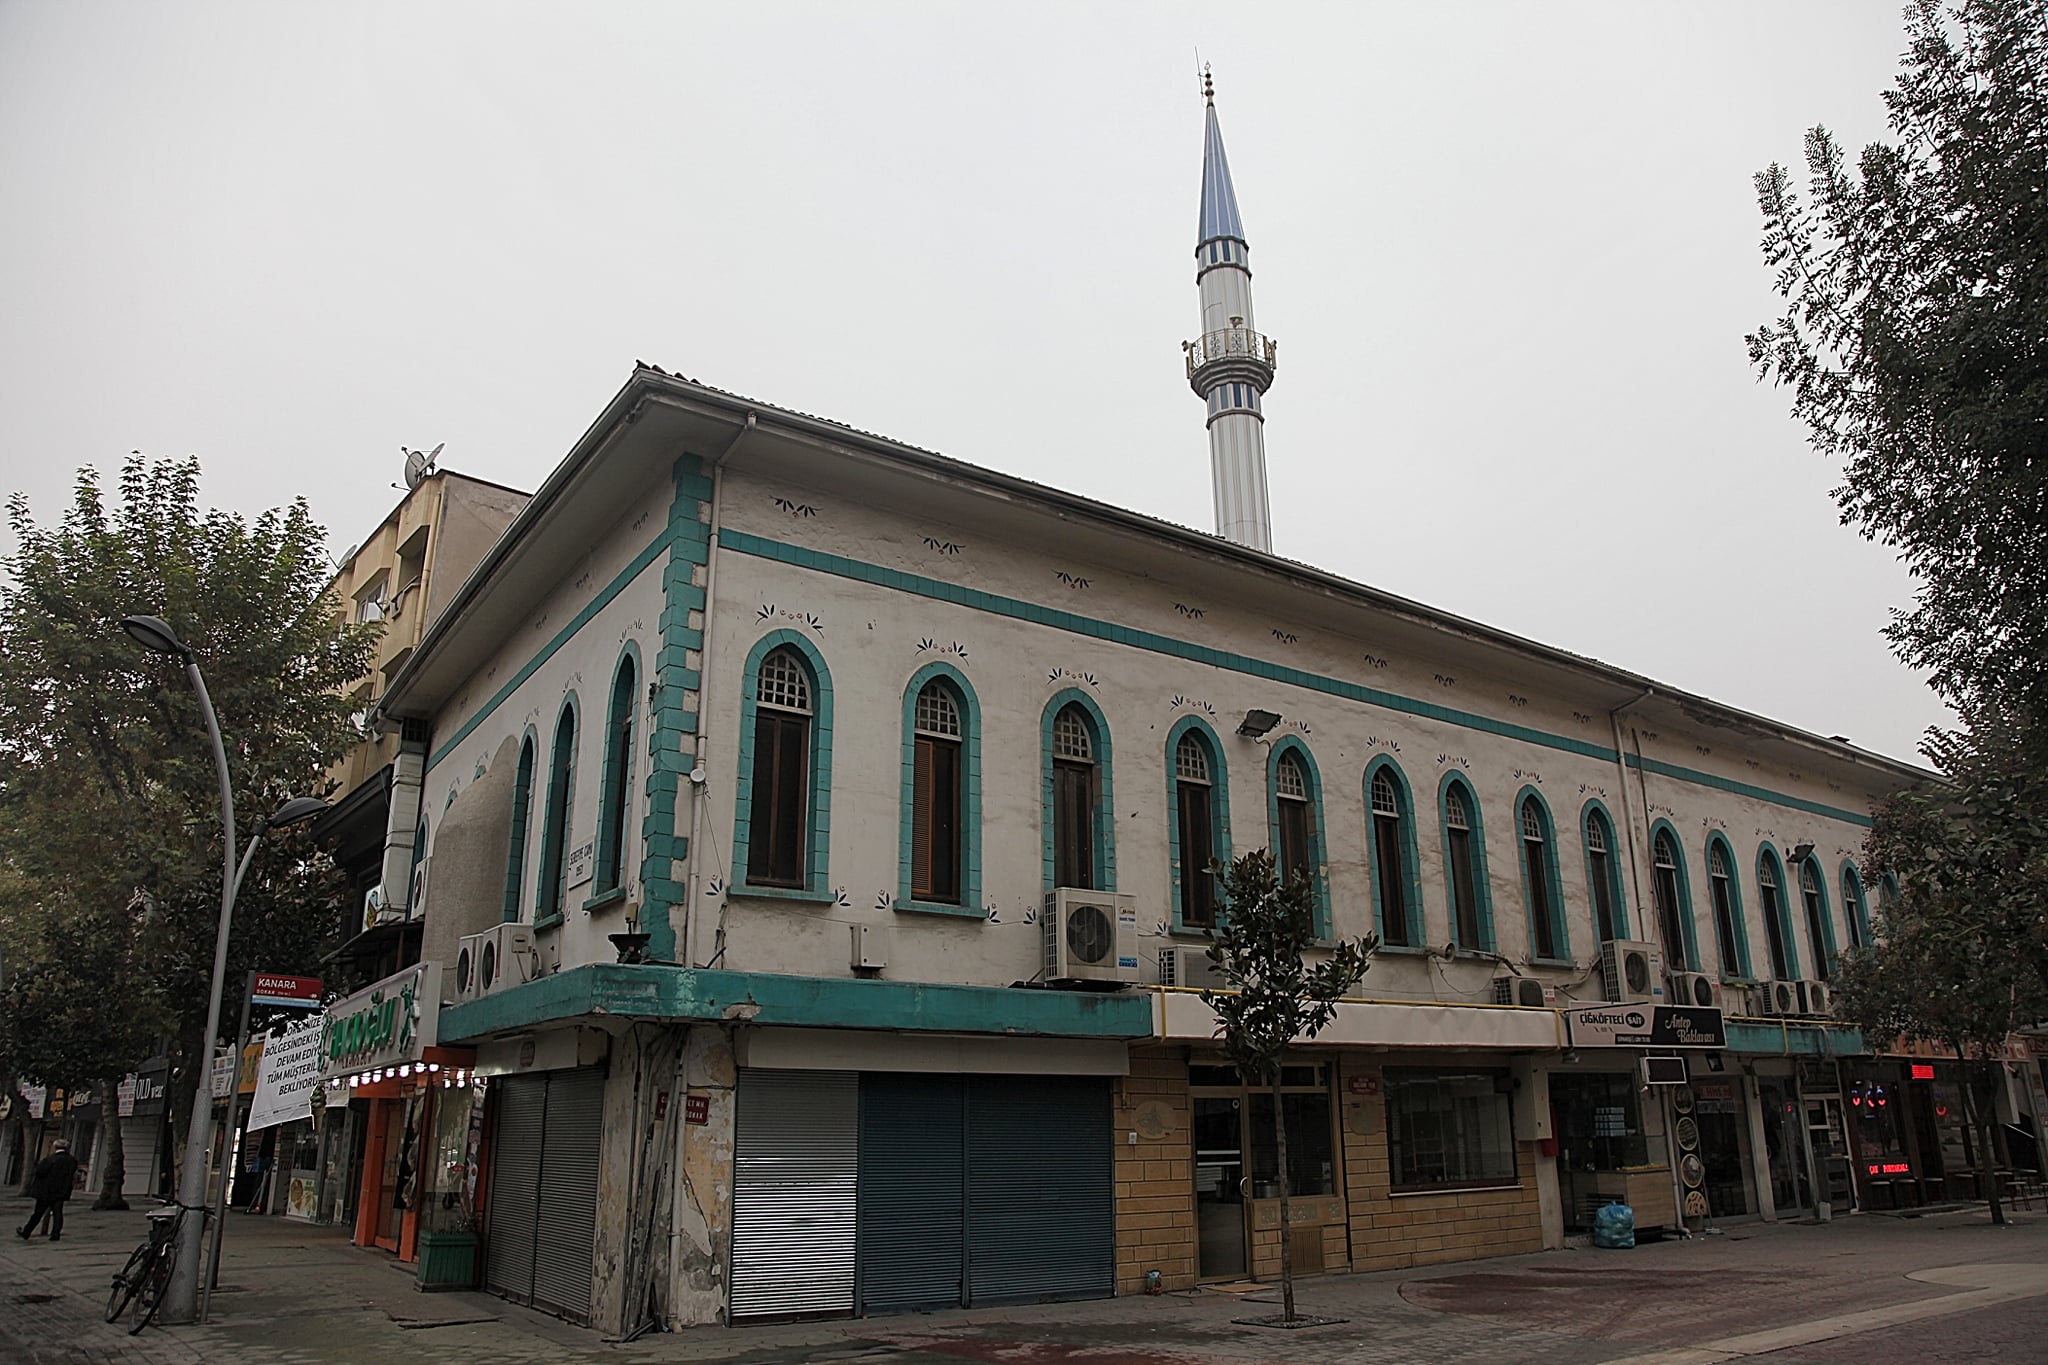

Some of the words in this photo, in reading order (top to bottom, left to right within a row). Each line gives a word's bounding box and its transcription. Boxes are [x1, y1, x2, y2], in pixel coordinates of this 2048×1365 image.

[258, 978, 297, 990] KANARA
[1580, 1011, 1625, 1027] ÇİĞKÖFTECİ
[1665, 1014, 1691, 1030] Antep
[264, 1031, 314, 1058] BÖLGESİNDEKİ
[1677, 1028, 1715, 1044] Baklavası
[276, 1051, 302, 1068] DEVAM
[267, 1069, 284, 1085] TÜM
[283, 1060, 318, 1081] MÜŞTERİL
[136, 1078, 152, 1101] OLD
[278, 1075, 319, 1096] BEKLİYORU
